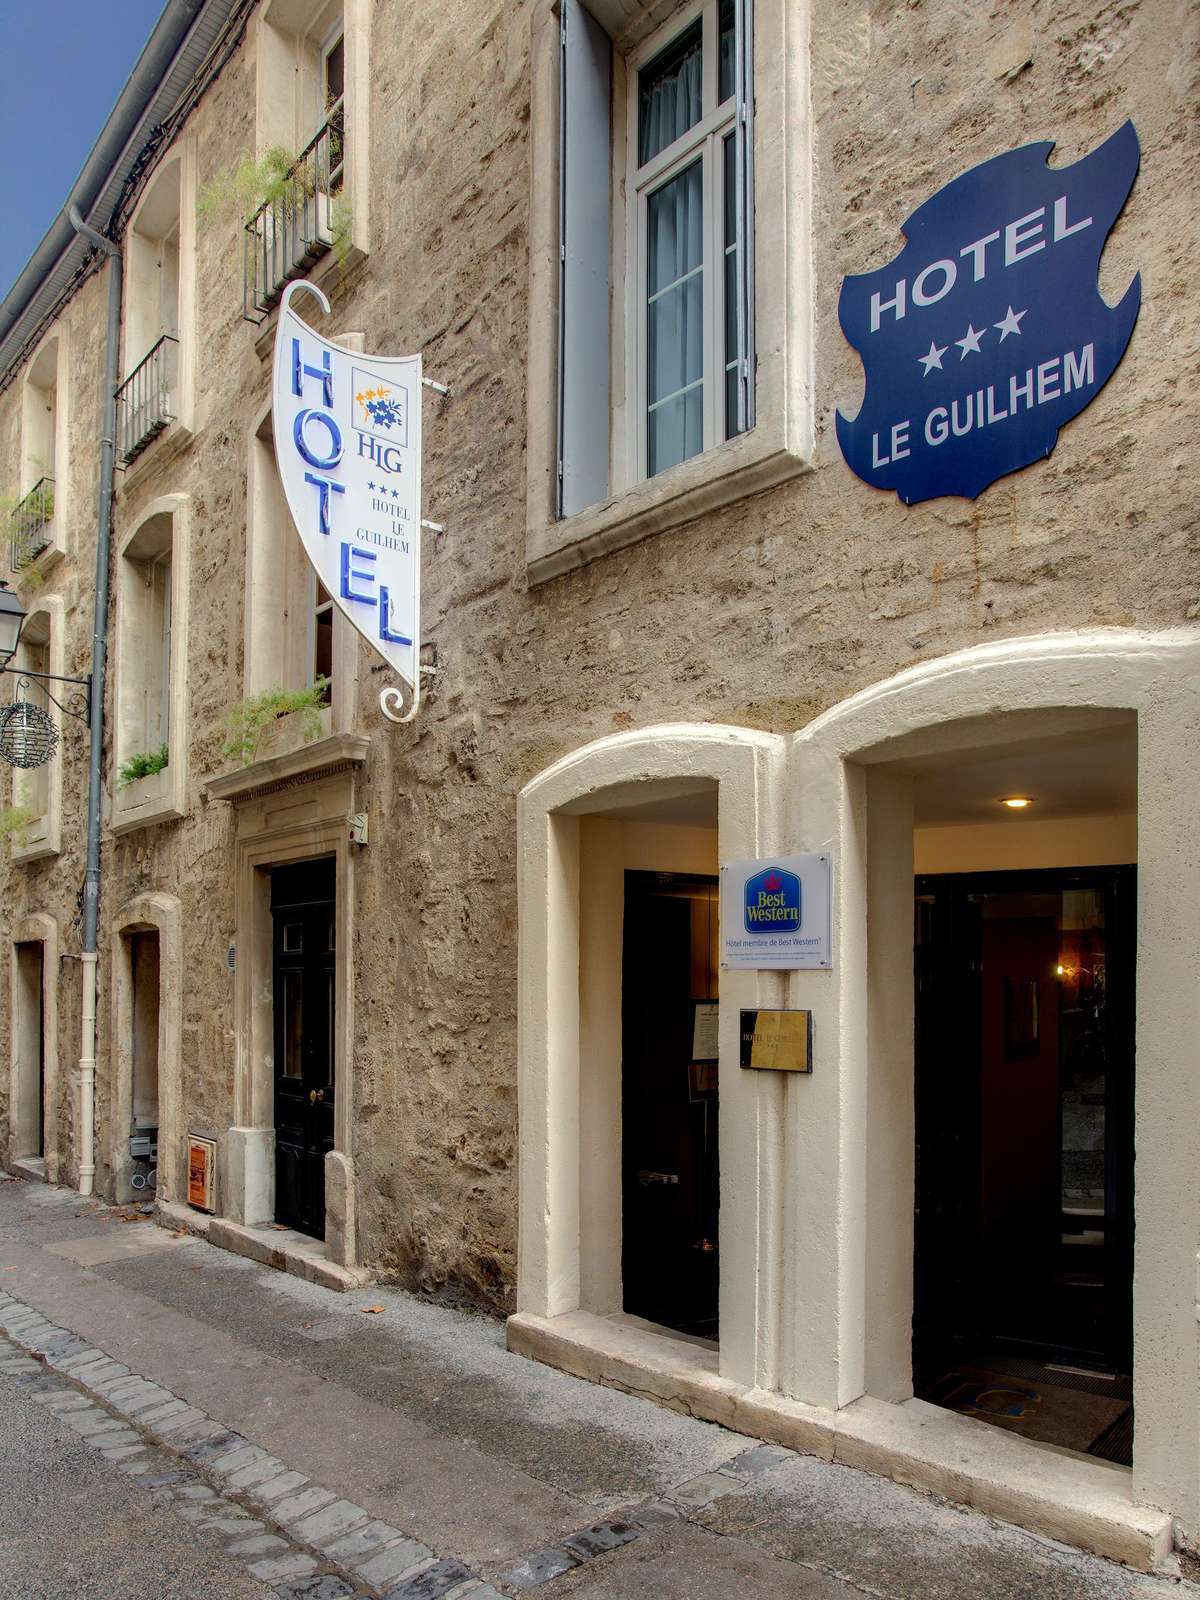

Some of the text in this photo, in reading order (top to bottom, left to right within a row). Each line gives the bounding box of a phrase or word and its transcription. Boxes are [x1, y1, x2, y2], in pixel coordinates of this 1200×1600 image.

[870, 195, 1093, 333] HOTEL
[872, 342, 1094, 469] LE GUILHEM
[357, 432, 402, 474] HLG
[291, 337, 413, 646] HOTEL
[372, 498, 410, 520] HOTEL
[392, 520, 405, 536] LE
[356, 527, 409, 554] GUILHEM
[757, 890, 786, 908] Best
[746, 905, 799, 922] Western
[769, 938, 777, 946] de
[778, 938, 792, 946] Best
